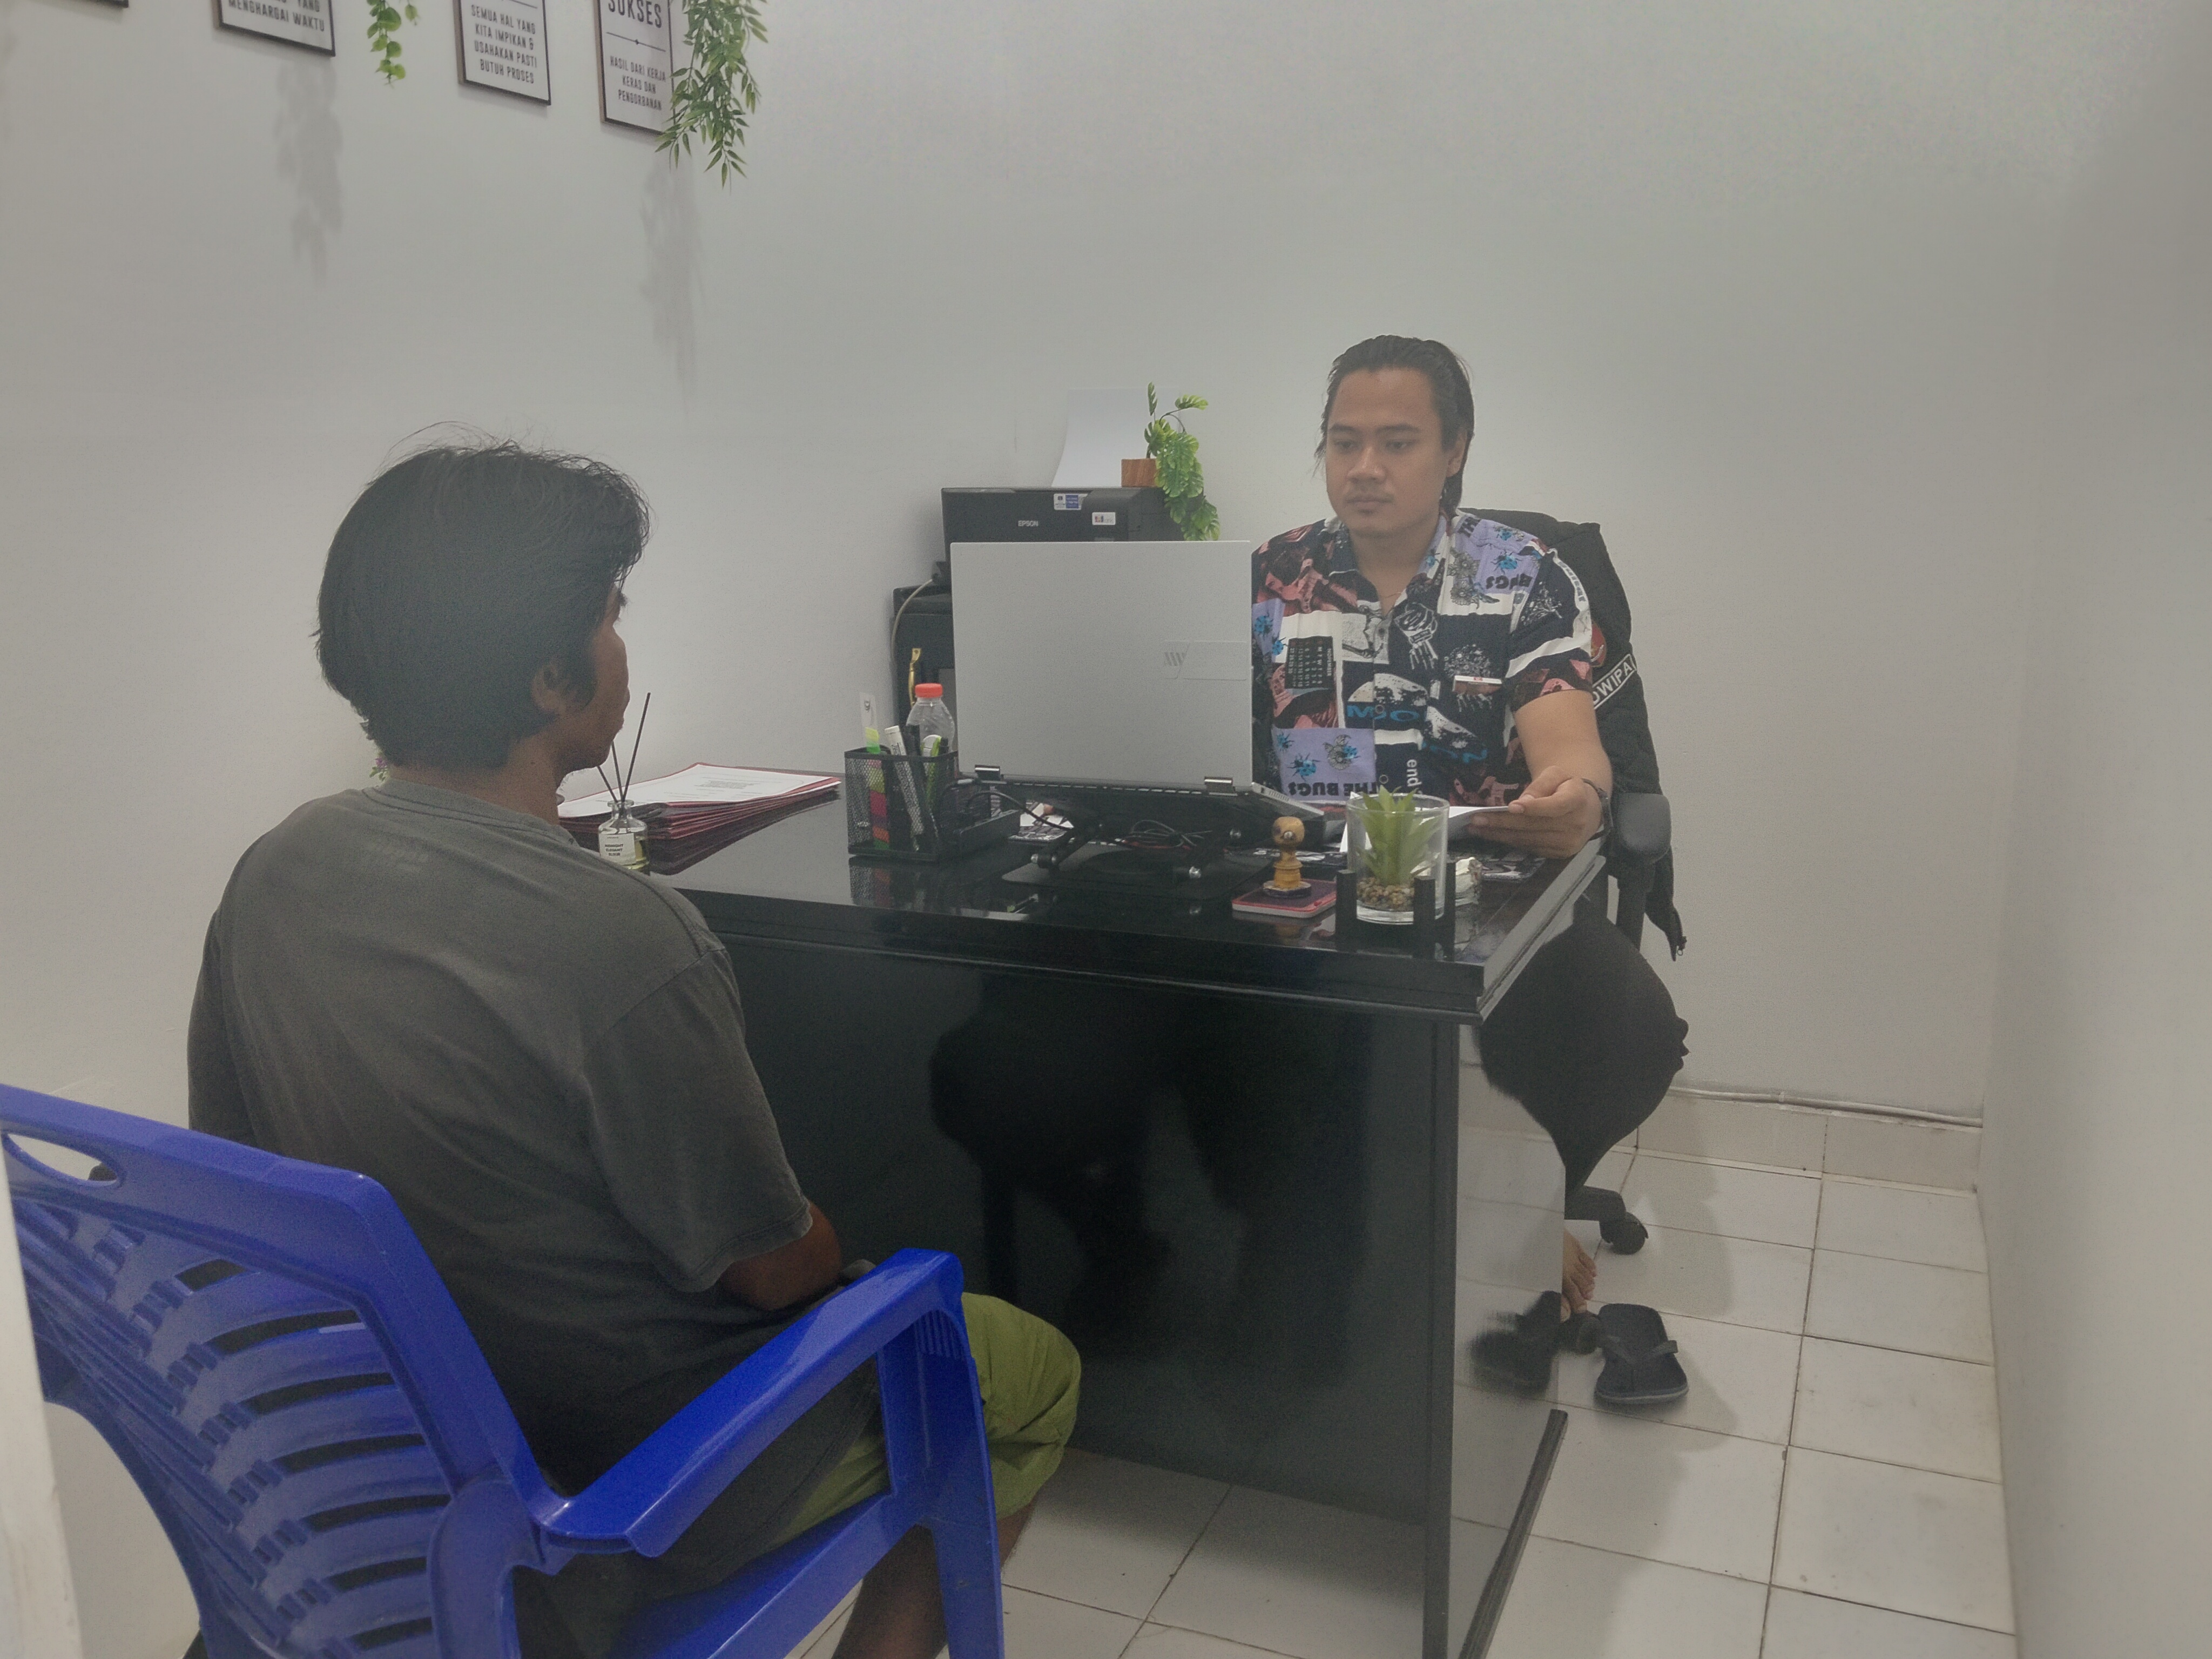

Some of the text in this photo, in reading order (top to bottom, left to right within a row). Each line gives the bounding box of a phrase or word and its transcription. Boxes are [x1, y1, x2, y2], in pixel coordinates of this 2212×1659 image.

[228, 0, 325, 31] MENGHARGAI WAKTU
[471, 4, 536, 35] SEMUA HAL YANG
[475, 23, 493, 38] KITA
[495, 29, 527, 49] IMPIKAN
[474, 40, 537, 69] USAHAKAN PASTI
[480, 59, 534, 84] BUTUH PROSES
[610, 56, 666, 82] HASIL DARI KERJA
[622, 75, 656, 94] KERAS DAN
[618, 90, 662, 110] PENGORBANAN
[1288, 781, 1339, 797] BUGS
